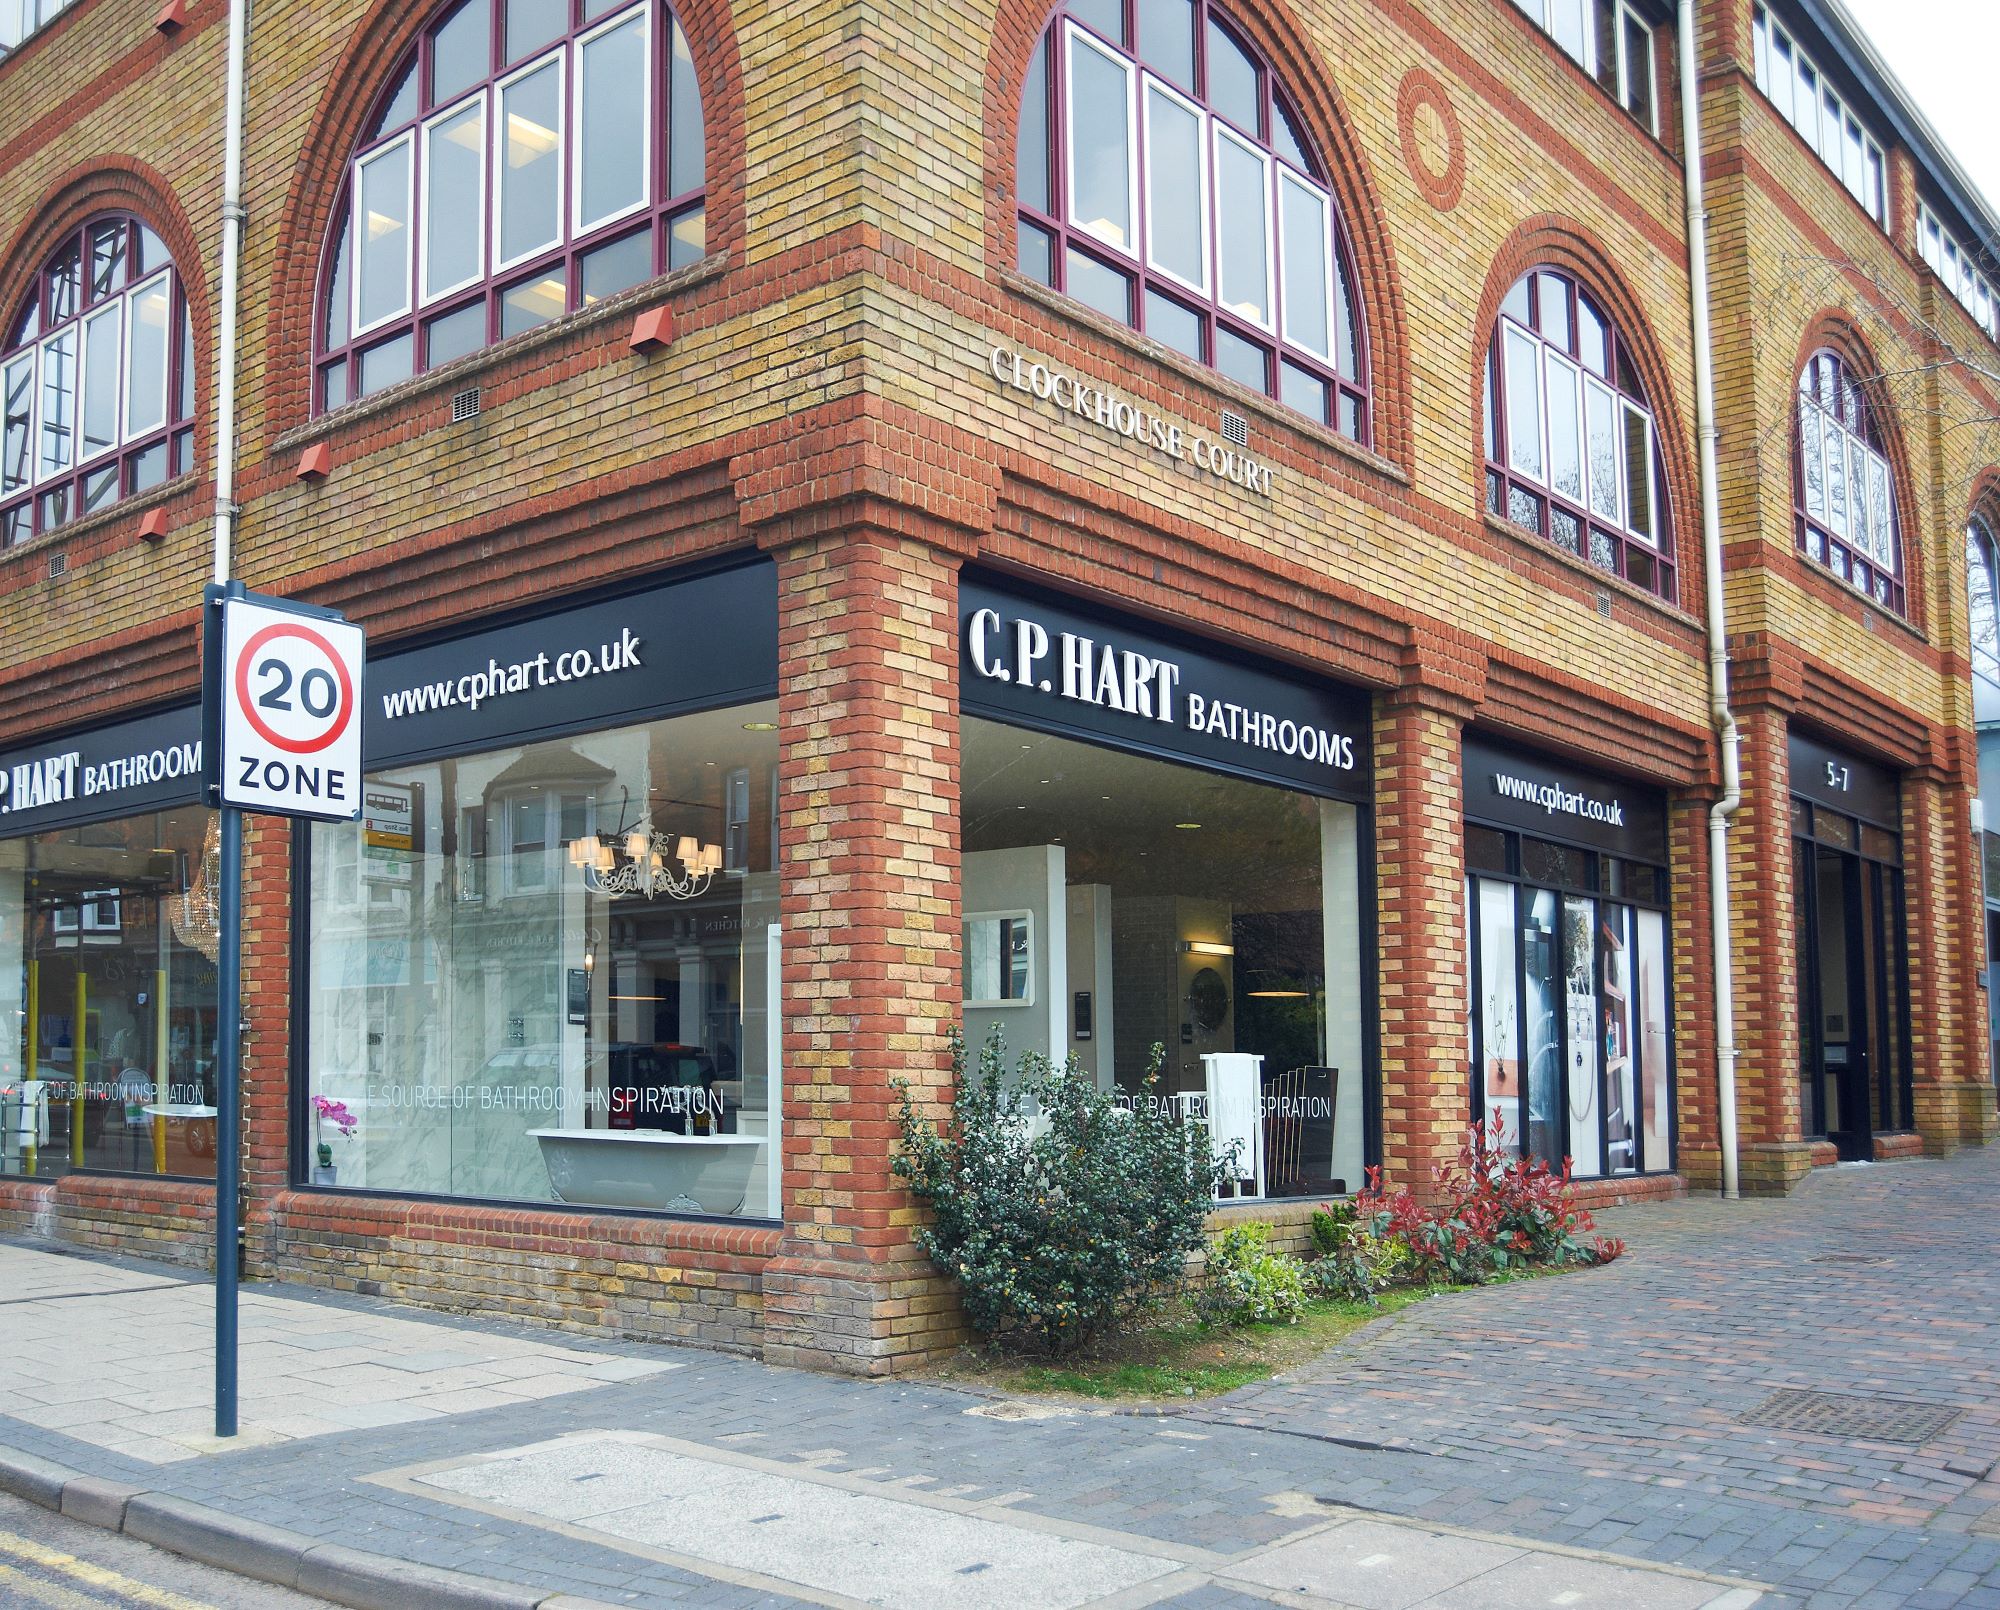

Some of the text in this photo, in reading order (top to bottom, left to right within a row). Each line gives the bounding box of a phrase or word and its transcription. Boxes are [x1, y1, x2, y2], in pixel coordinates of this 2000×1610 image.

[988, 346, 1274, 498] CLOCKHOUSE COURT
[257, 658, 338, 719] 20
[382, 627, 641, 719] www.cphart.co.uk
[1060, 631, 1180, 724] HART
[1187, 692, 1355, 771] BATHROOMS
[12, 751, 81, 812] HART
[239, 755, 346, 801] ZONE
[1495, 773, 1624, 827] www.cphart.co.uk
[1827, 761, 1848, 791] 5-7
[70, 1081, 129, 1102] BATHROOM
[381, 1084, 449, 1109] SOURCE
[453, 1085, 476, 1110] OF
[481, 1086, 583, 1111] BATHROOM
[591, 1086, 725, 1115] INSPIRATION
